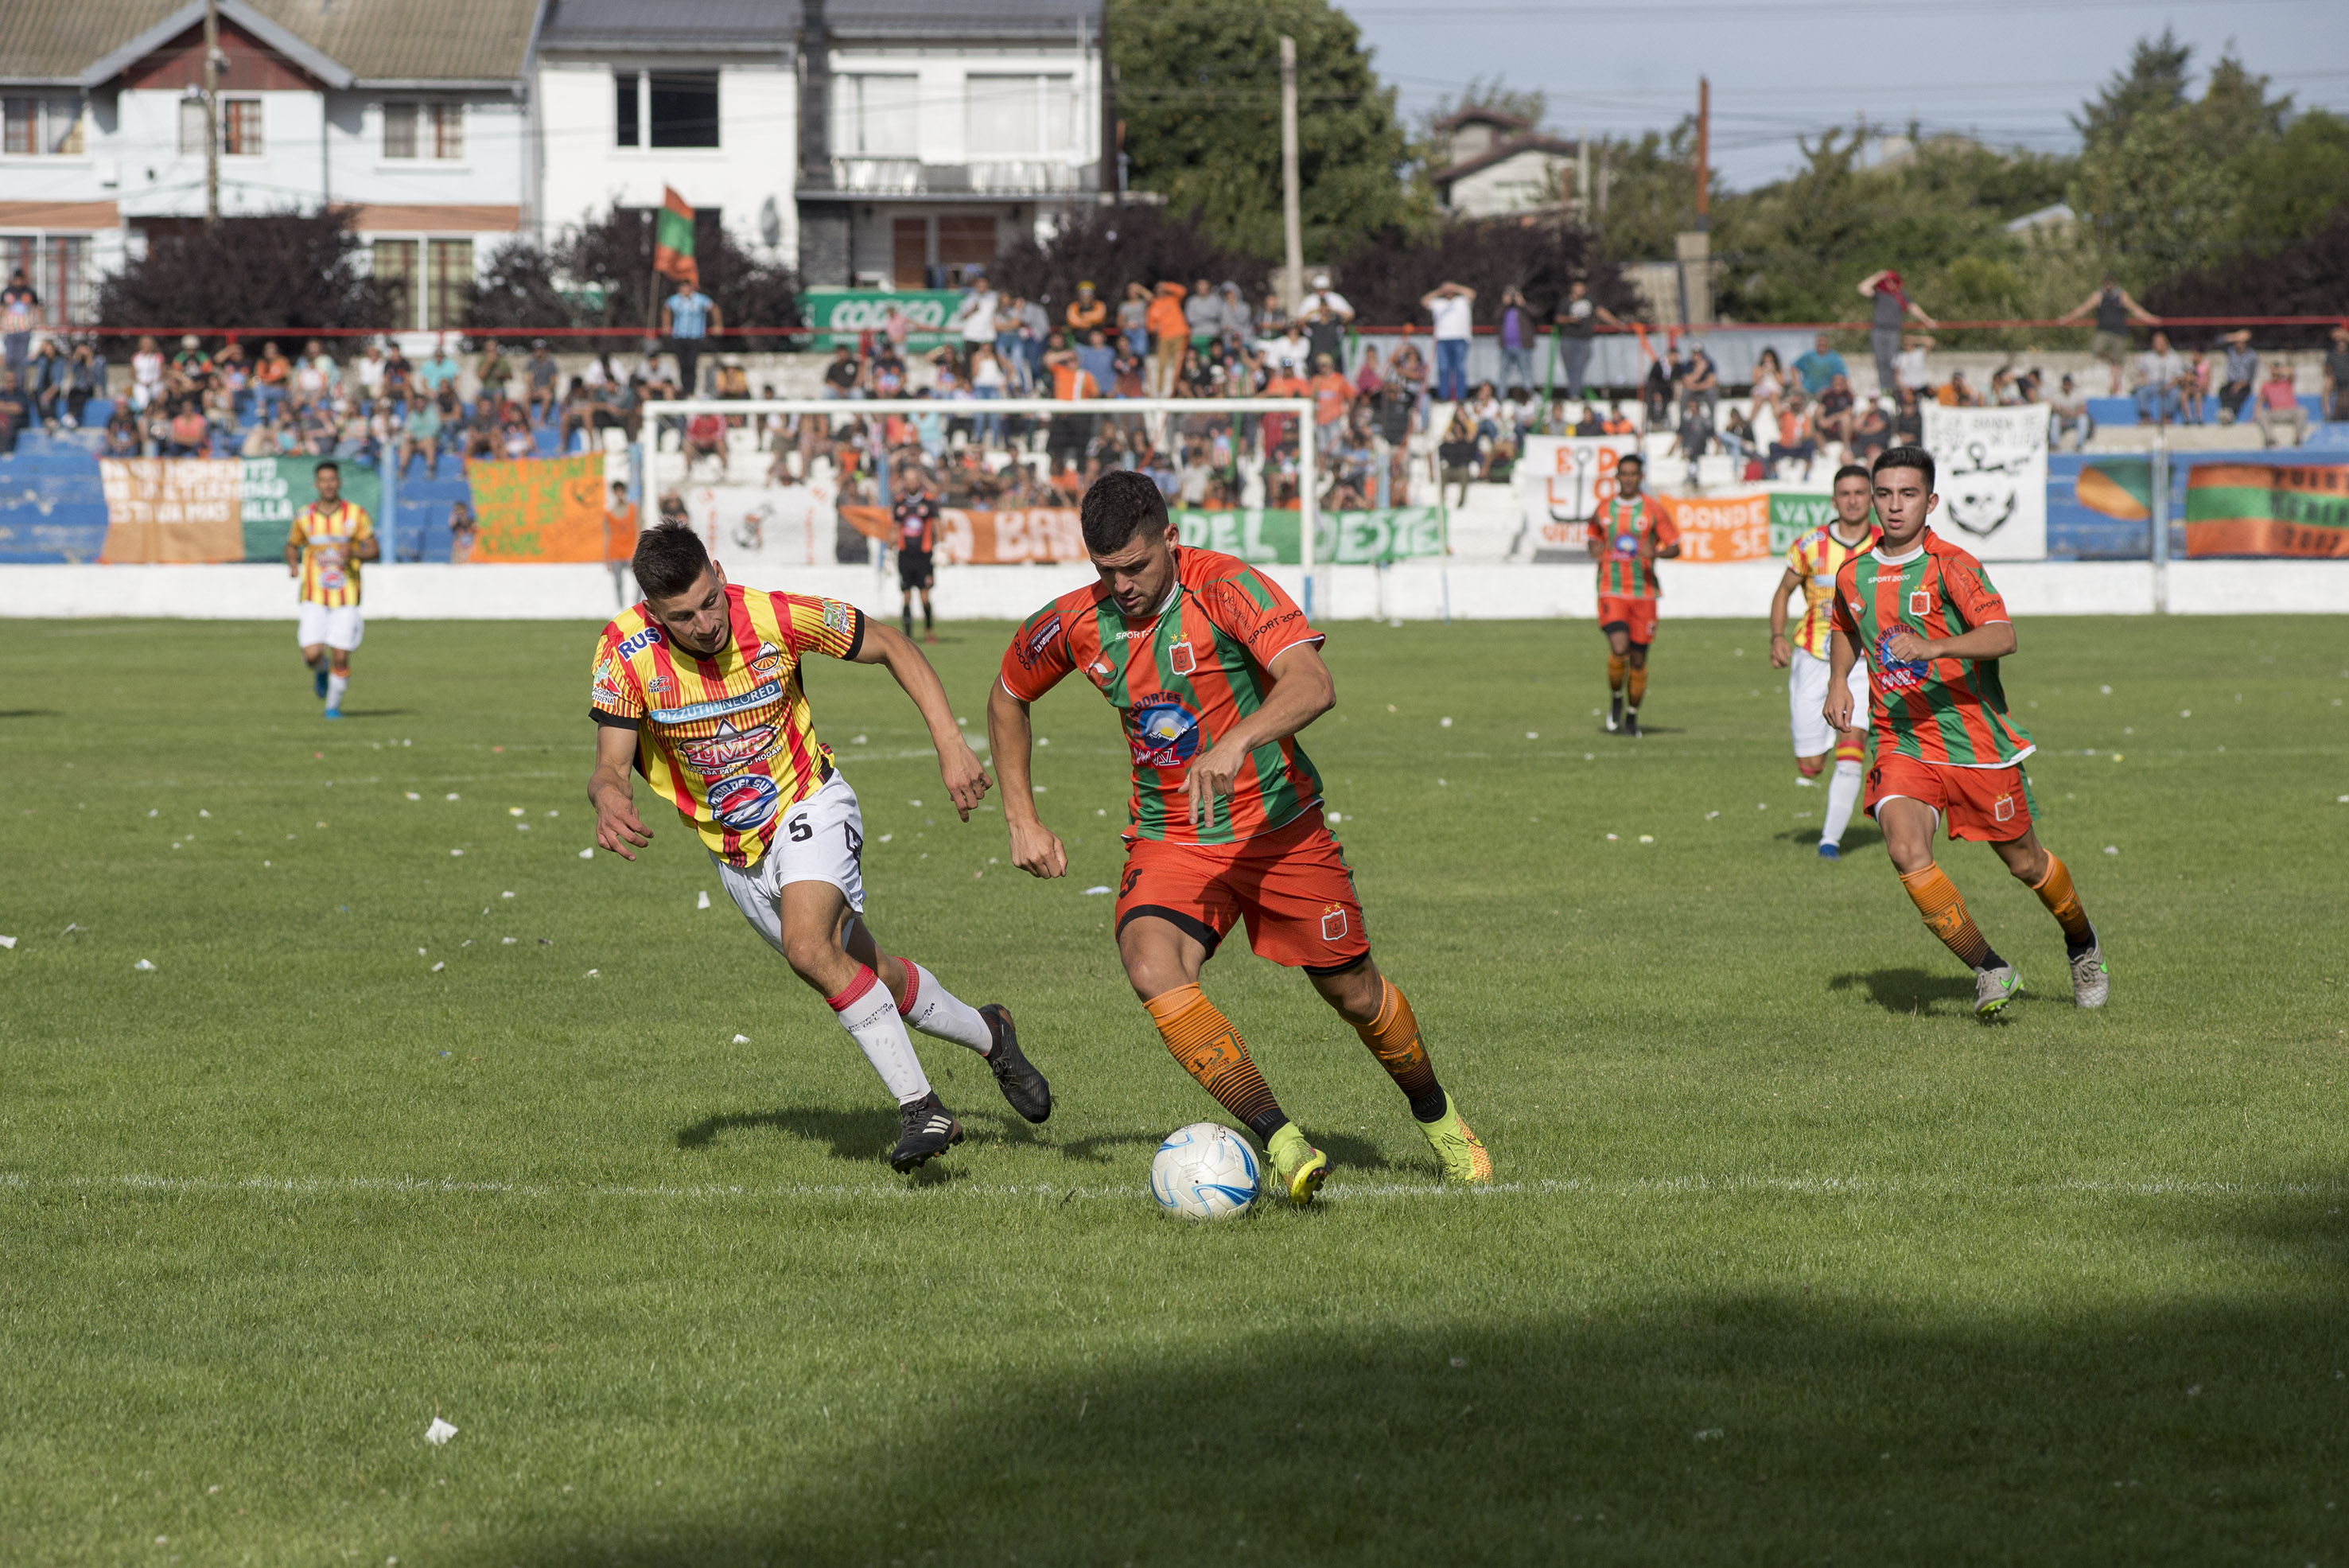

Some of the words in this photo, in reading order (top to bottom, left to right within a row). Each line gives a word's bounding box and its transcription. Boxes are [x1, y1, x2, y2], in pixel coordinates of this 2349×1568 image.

[1676, 500, 1768, 531] DONDE
[995, 508, 1083, 562] BAN
[1180, 511, 1278, 562] DEL
[1679, 531, 1715, 558] TE
[618, 627, 662, 661] RUS
[1115, 630, 1148, 640] SPORT
[1248, 617, 1280, 646] SPORT
[1014, 639, 1031, 671] 2000
[658, 703, 710, 722] PIZZUTI
[722, 683, 776, 710] NEORED
[697, 768, 718, 776] CASA
[754, 745, 784, 764] HOGAR
[788, 812, 814, 842] 5
